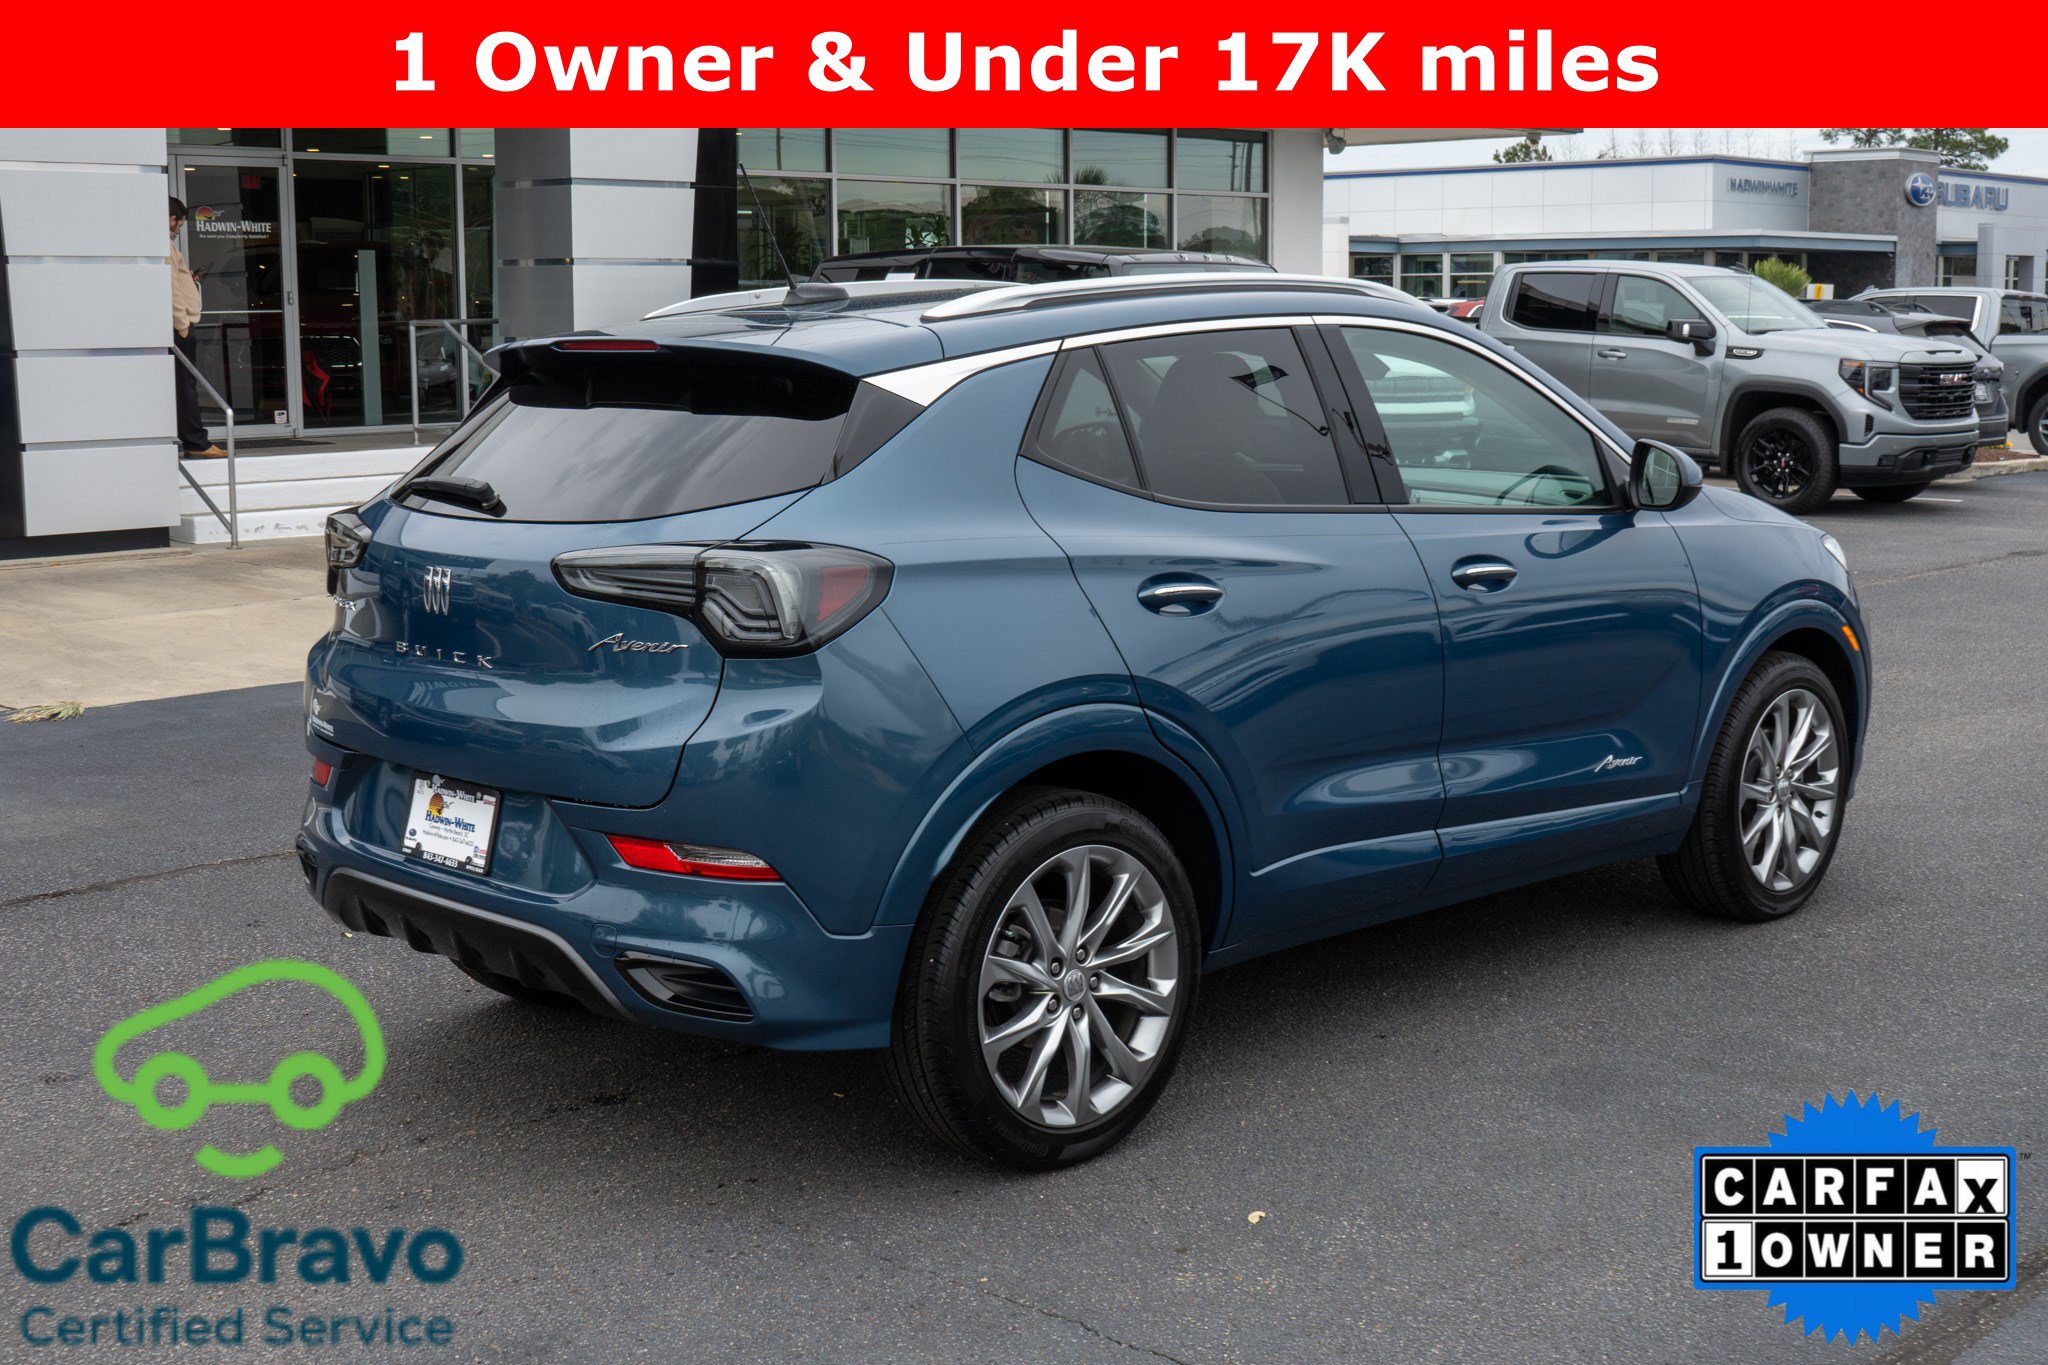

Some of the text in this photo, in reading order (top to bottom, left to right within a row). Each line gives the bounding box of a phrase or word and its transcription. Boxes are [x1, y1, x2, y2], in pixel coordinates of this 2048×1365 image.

[588, 631, 689, 653] Avenir
[395, 640, 494, 669] BUICK
[1594, 754, 1643, 772] Avenir
[425, 810, 475, 832] HADWIN-WHITE
